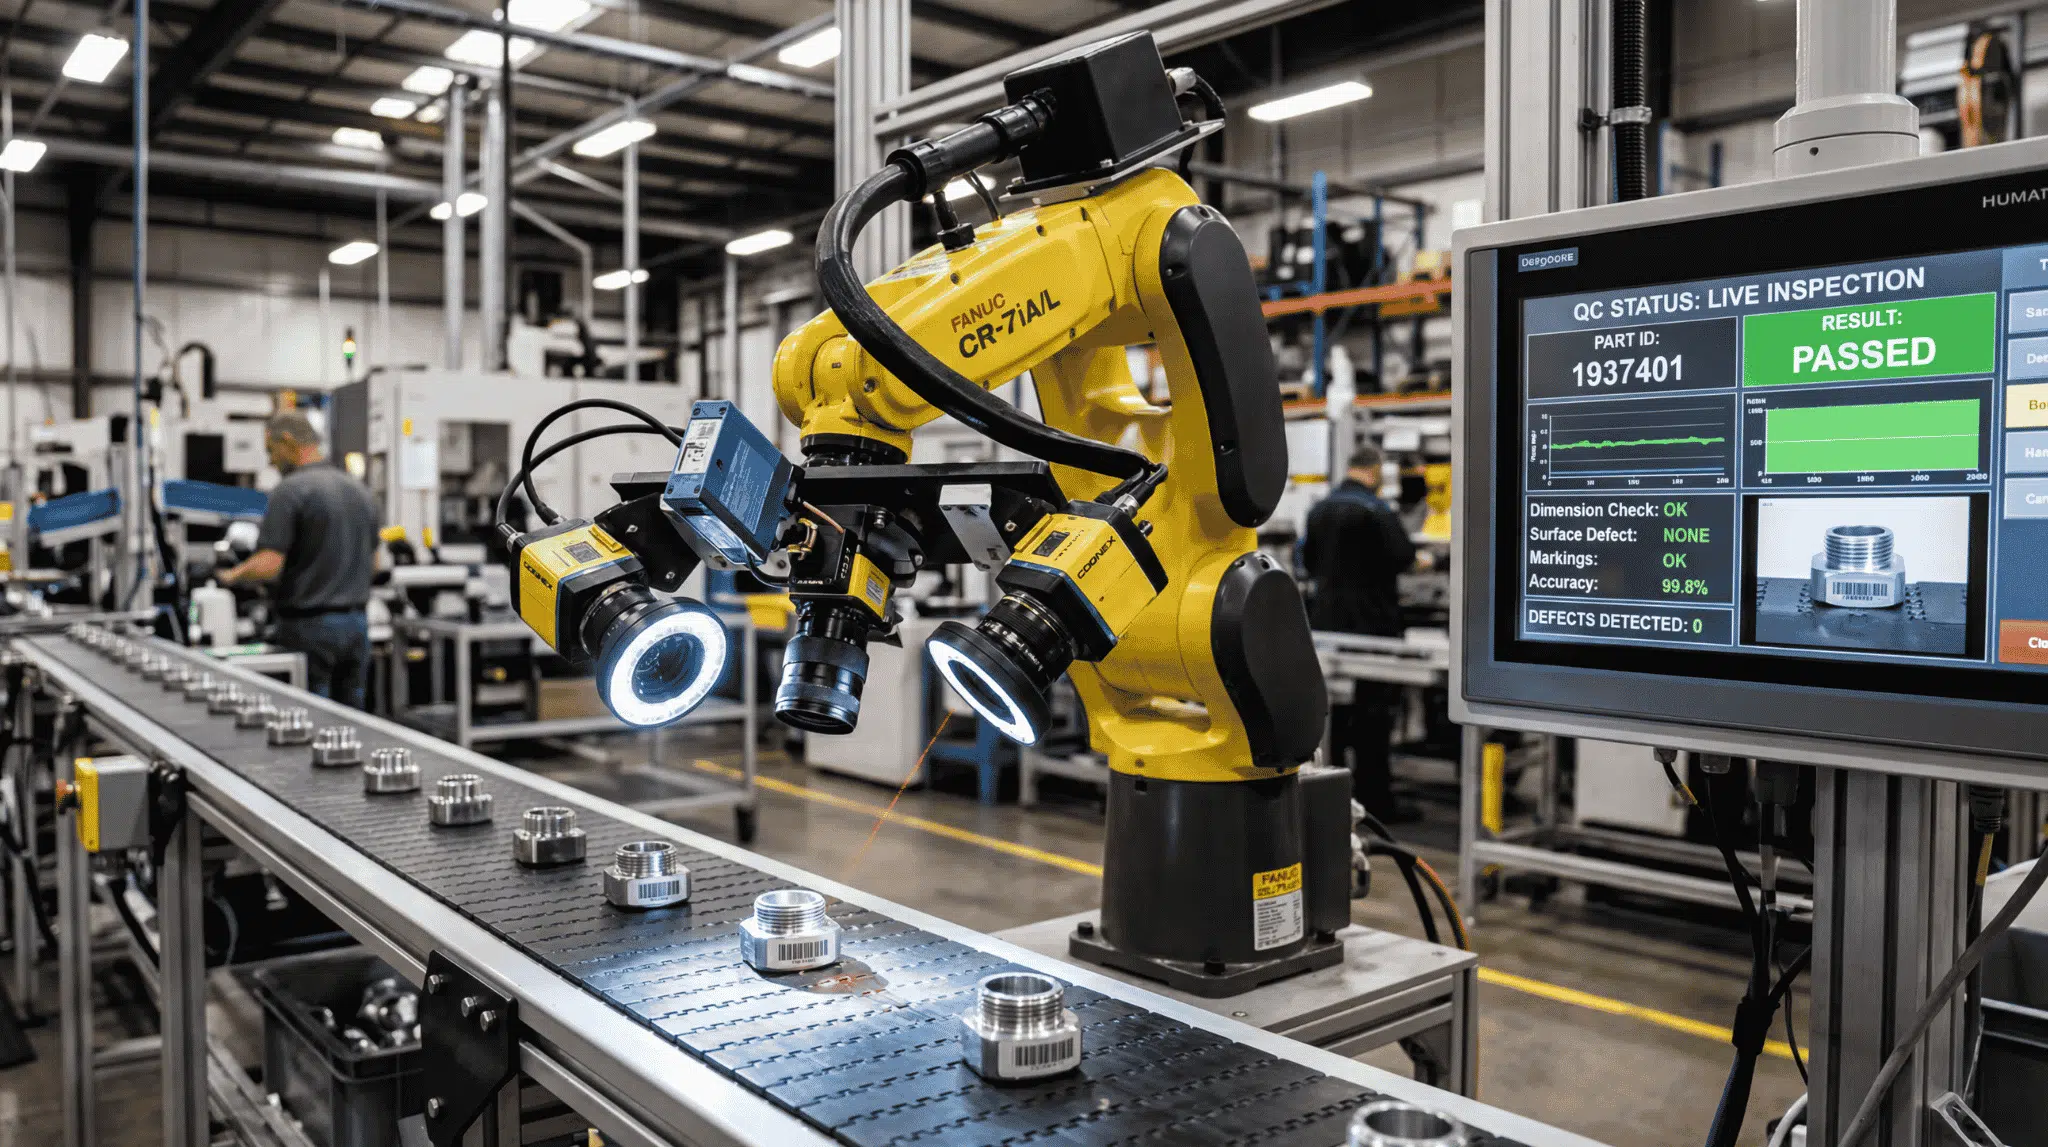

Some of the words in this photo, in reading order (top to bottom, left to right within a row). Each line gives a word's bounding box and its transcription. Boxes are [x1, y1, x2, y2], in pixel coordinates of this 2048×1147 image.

[1573, 301, 1604, 321] QC
[1611, 292, 1700, 317] STATUS:
[1708, 285, 1760, 309] LIVE
[1767, 267, 1926, 302] INSPECTION
[951, 293, 1006, 333] FANUC
[959, 289, 1061, 358] CR-7iA/L
[1822, 309, 1903, 331] RESULT:
[1594, 332, 1635, 350] PART
[1639, 331, 1660, 346] ID:
[1793, 337, 1937, 374] PASSED
[1572, 354, 1683, 387] 1937401
[1530, 503, 1604, 517] Dimension
[1607, 502, 1659, 517] Check:
[1663, 501, 1688, 517] OK
[1530, 527, 1583, 542] Surface
[1586, 527, 1638, 542] Defect:
[1663, 527, 1710, 543] NONE
[1530, 550, 1598, 569] Markings:
[1662, 553, 1688, 568] OK
[1529, 573, 1599, 594] Accuracy:
[1662, 578, 1709, 596] 99.8%
[1528, 609, 1596, 627] DEFECTS
[1599, 613, 1689, 633] DETECTED:
[1692, 618, 1703, 634] 0
